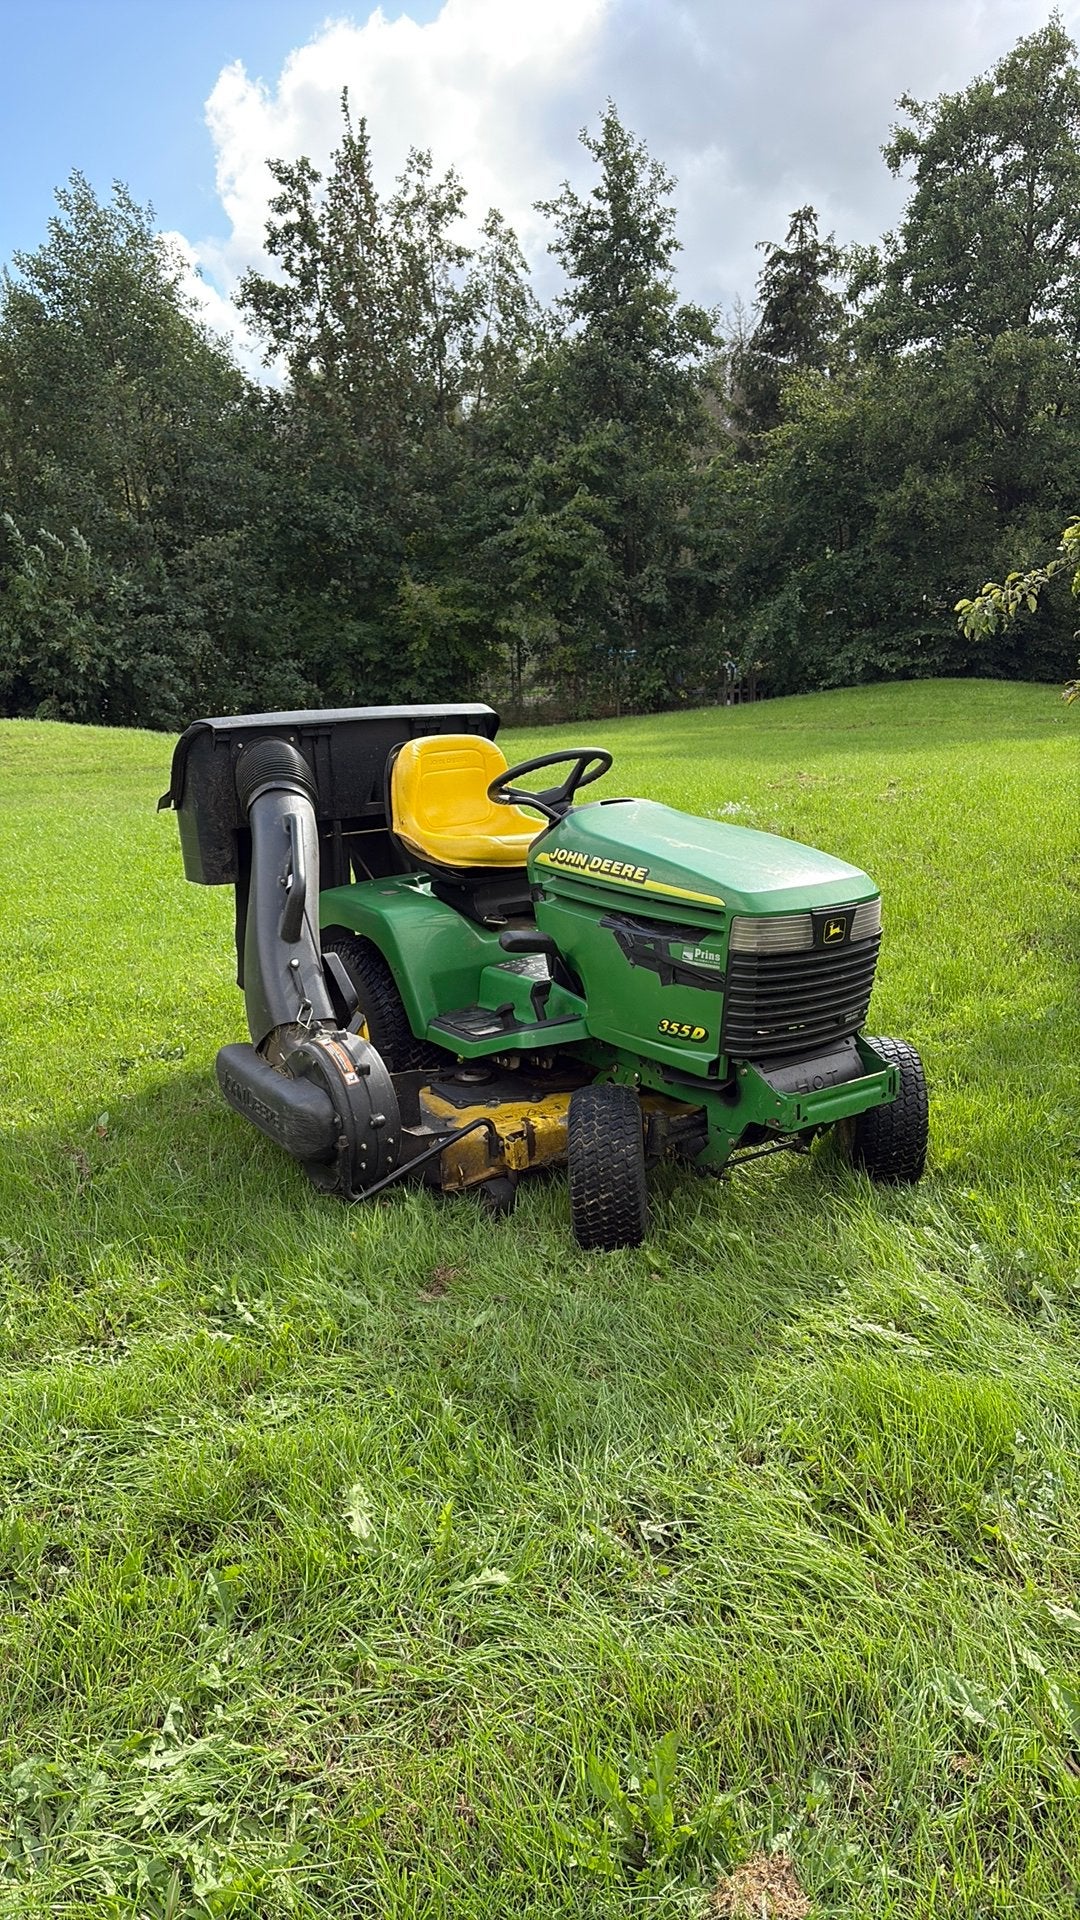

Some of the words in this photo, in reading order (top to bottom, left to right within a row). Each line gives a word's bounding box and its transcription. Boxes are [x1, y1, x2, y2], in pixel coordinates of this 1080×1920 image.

[549, 847, 588, 869] JOHN
[588, 856, 649, 883] DEERE
[694, 948, 720, 961] Prins
[658, 1019, 707, 1041] 355D
[795, 1069, 838, 1093] HOT
